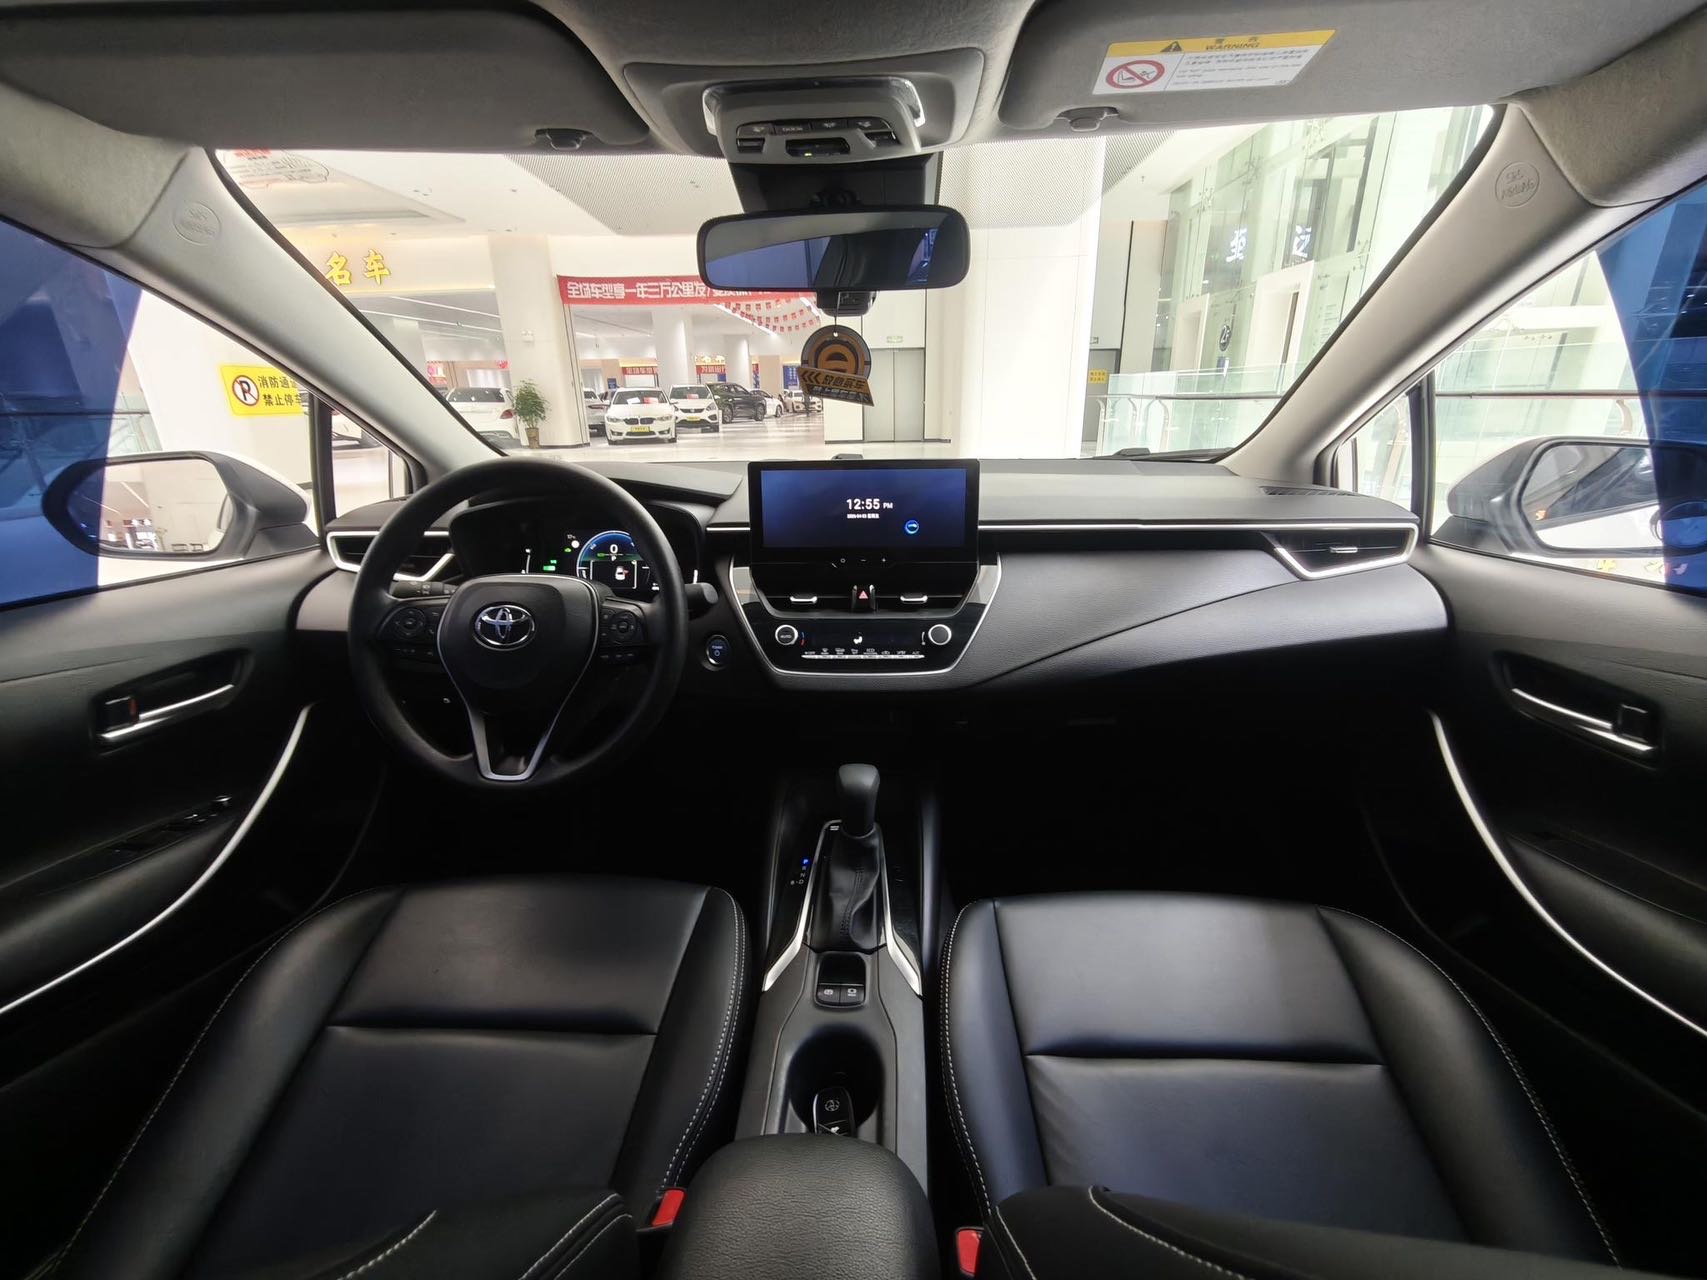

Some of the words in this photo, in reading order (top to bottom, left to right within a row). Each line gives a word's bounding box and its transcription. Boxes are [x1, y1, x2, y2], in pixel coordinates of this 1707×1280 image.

[325, 249, 391, 286] 名车
[846, 498, 880, 510] 12:55
[609, 543, 619, 554] 0
